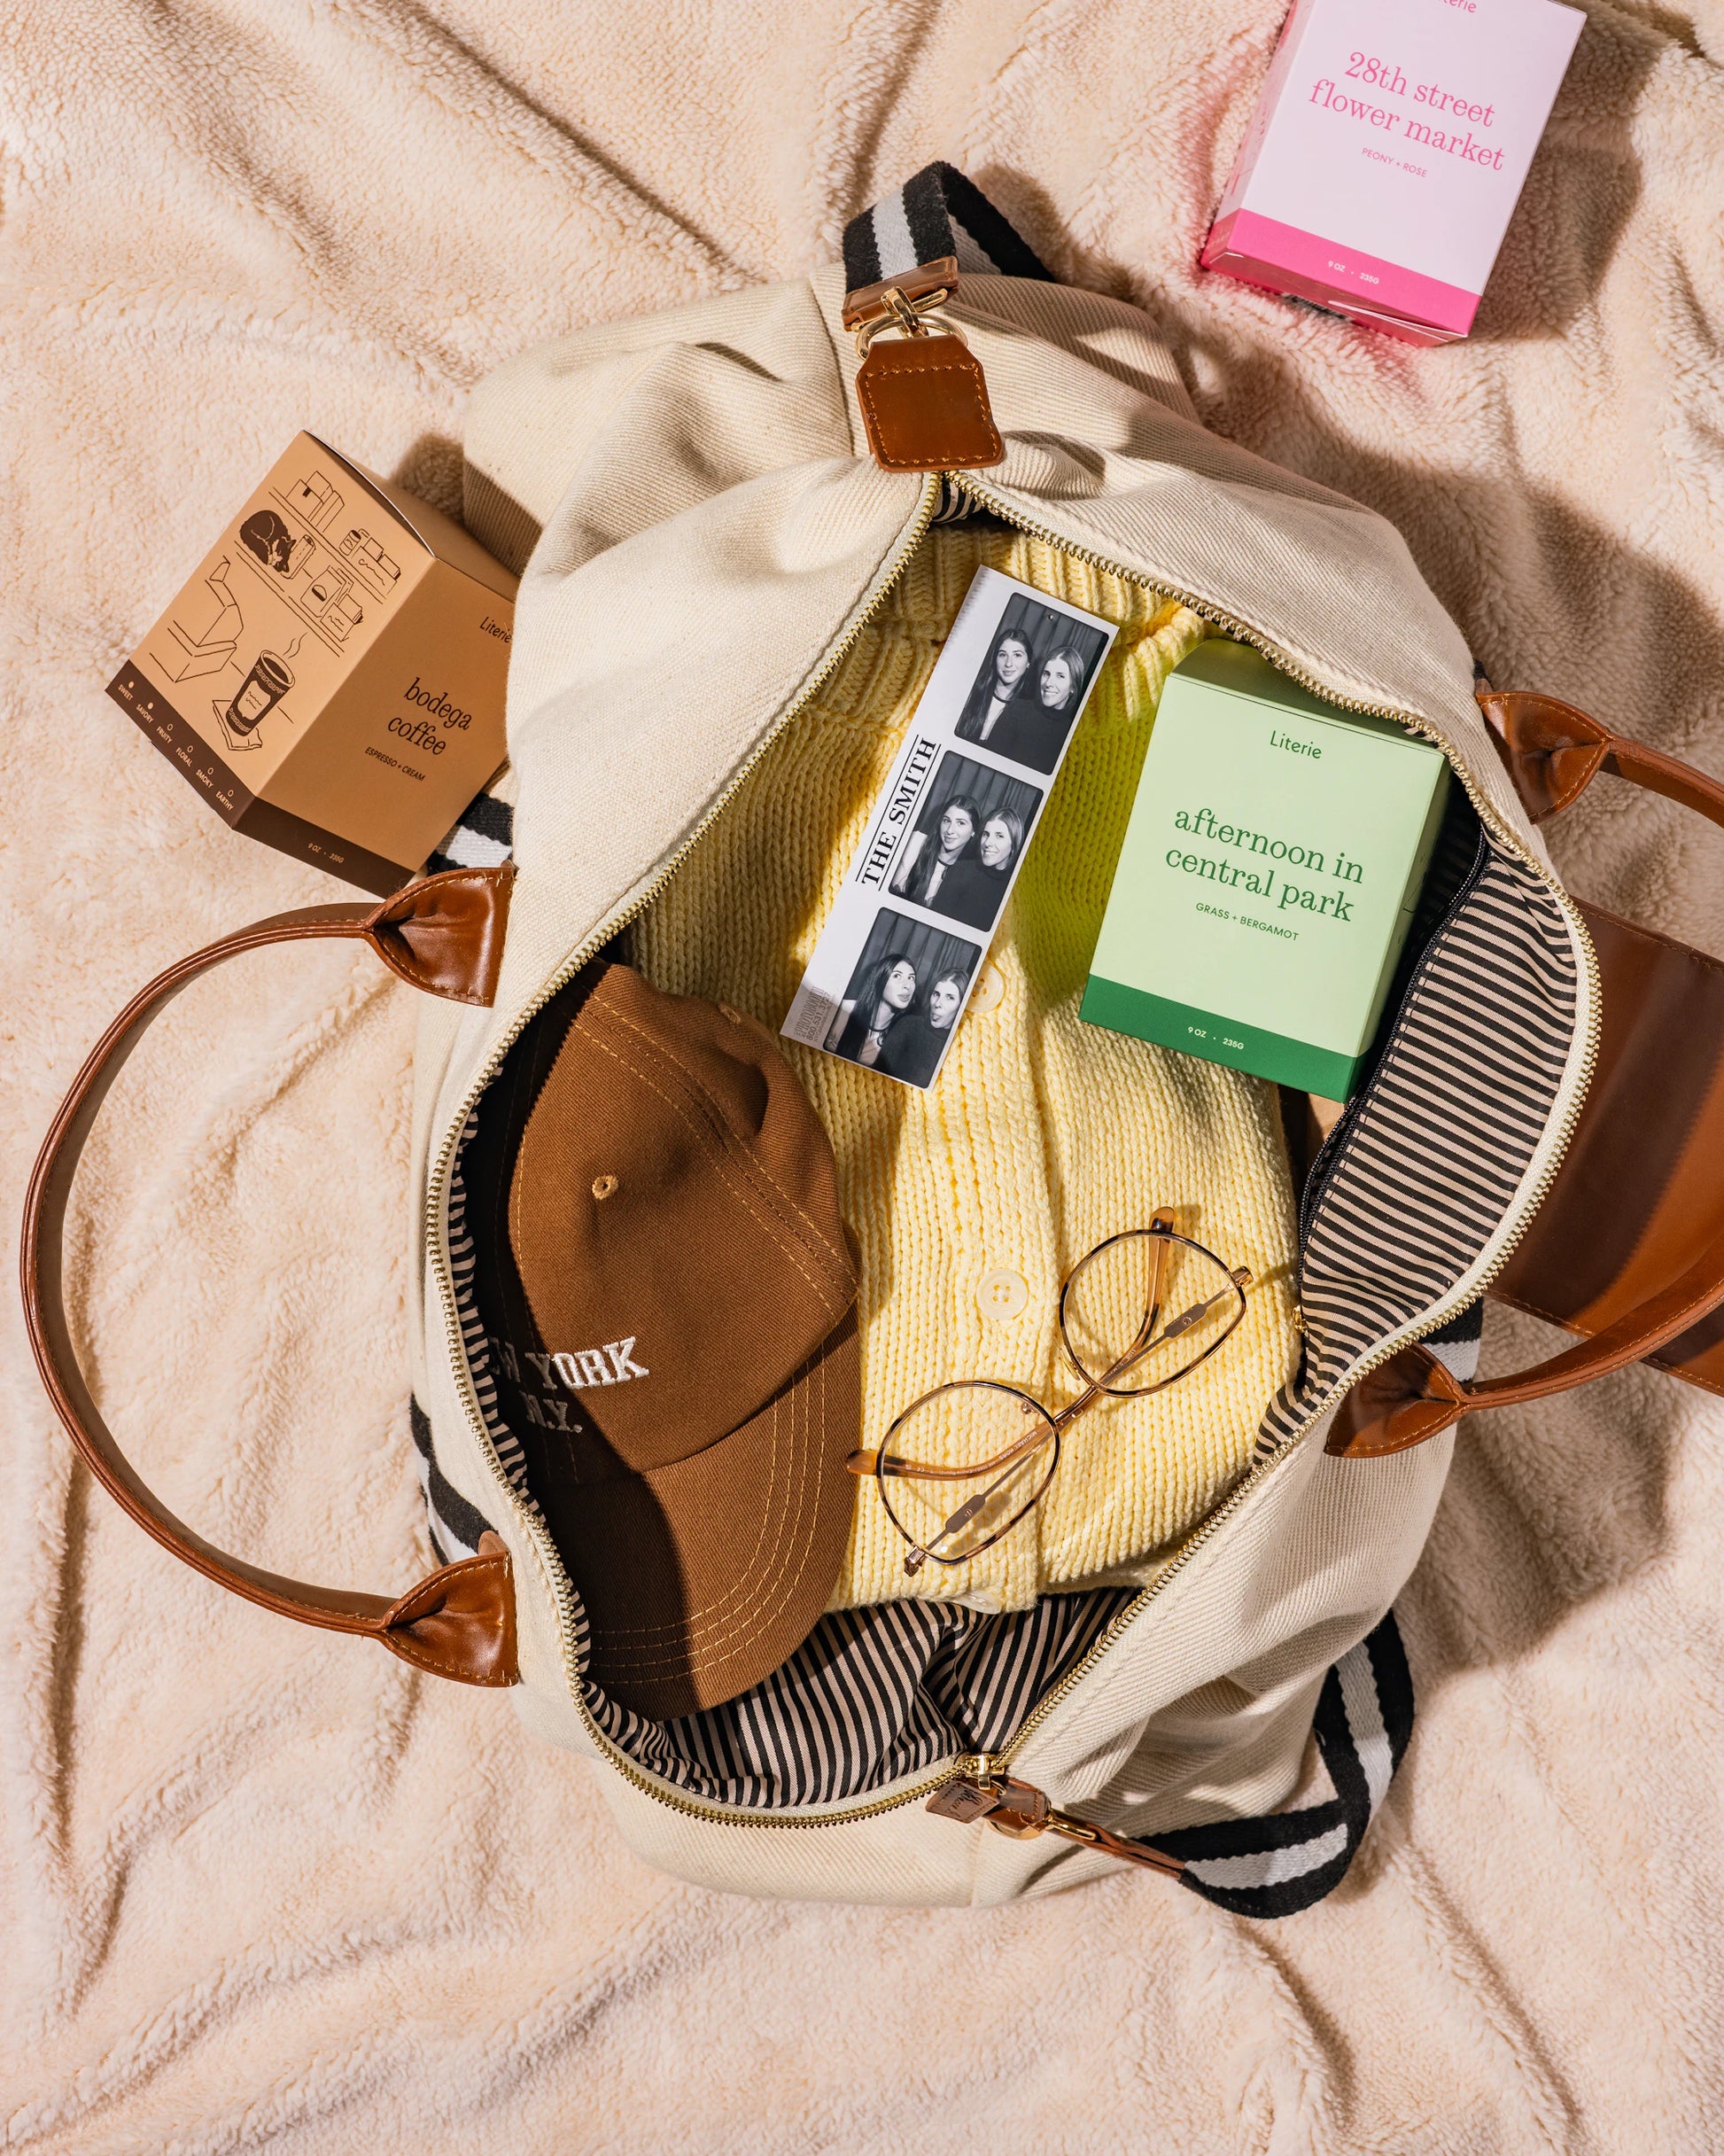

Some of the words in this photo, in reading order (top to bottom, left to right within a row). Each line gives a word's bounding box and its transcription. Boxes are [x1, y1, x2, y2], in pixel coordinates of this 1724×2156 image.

[1345, 52, 1406, 96] 28th
[1414, 84, 1495, 127] street
[1309, 79, 1400, 130] flower
[1404, 121, 1504, 170] market
[1362, 148, 1394, 164] PEONY
[1403, 163, 1427, 177] ROSE
[1335, 262, 1347, 274] OZ
[1359, 271, 1379, 284] 235G
[480, 617, 513, 643] Literie
[118, 684, 133, 701] SWEET
[404, 677, 471, 730] bodega
[136, 704, 154, 723] SAVORY
[156, 726, 173, 744] FRUITY
[388, 718, 446, 755] coffee
[1270, 730, 1322, 759] Literie
[175, 747, 193, 767] FLORAL
[365, 747, 399, 767] ESPRESSO
[402, 767, 425, 781] CREAM
[196, 769, 214, 789] SMOKY
[215, 790, 235, 811] EARTHY
[861, 831, 897, 884] THE
[889, 737, 936, 825] SMITH
[1175, 808, 1324, 872] afternoon
[1332, 852, 1363, 883] in
[1166, 850, 1274, 897] central
[1277, 884, 1354, 922] park
[1196, 903, 1229, 919] GRASS
[1240, 916, 1299, 940] BERGAMOT
[1194, 1029, 1207, 1038] OZ
[1223, 1038, 1244, 1049] 235G
[524, 1336, 649, 1390] YORK
[998, 1448, 1014, 1460] KORS
[1014, 1431, 1037, 1449] MICHAEL
